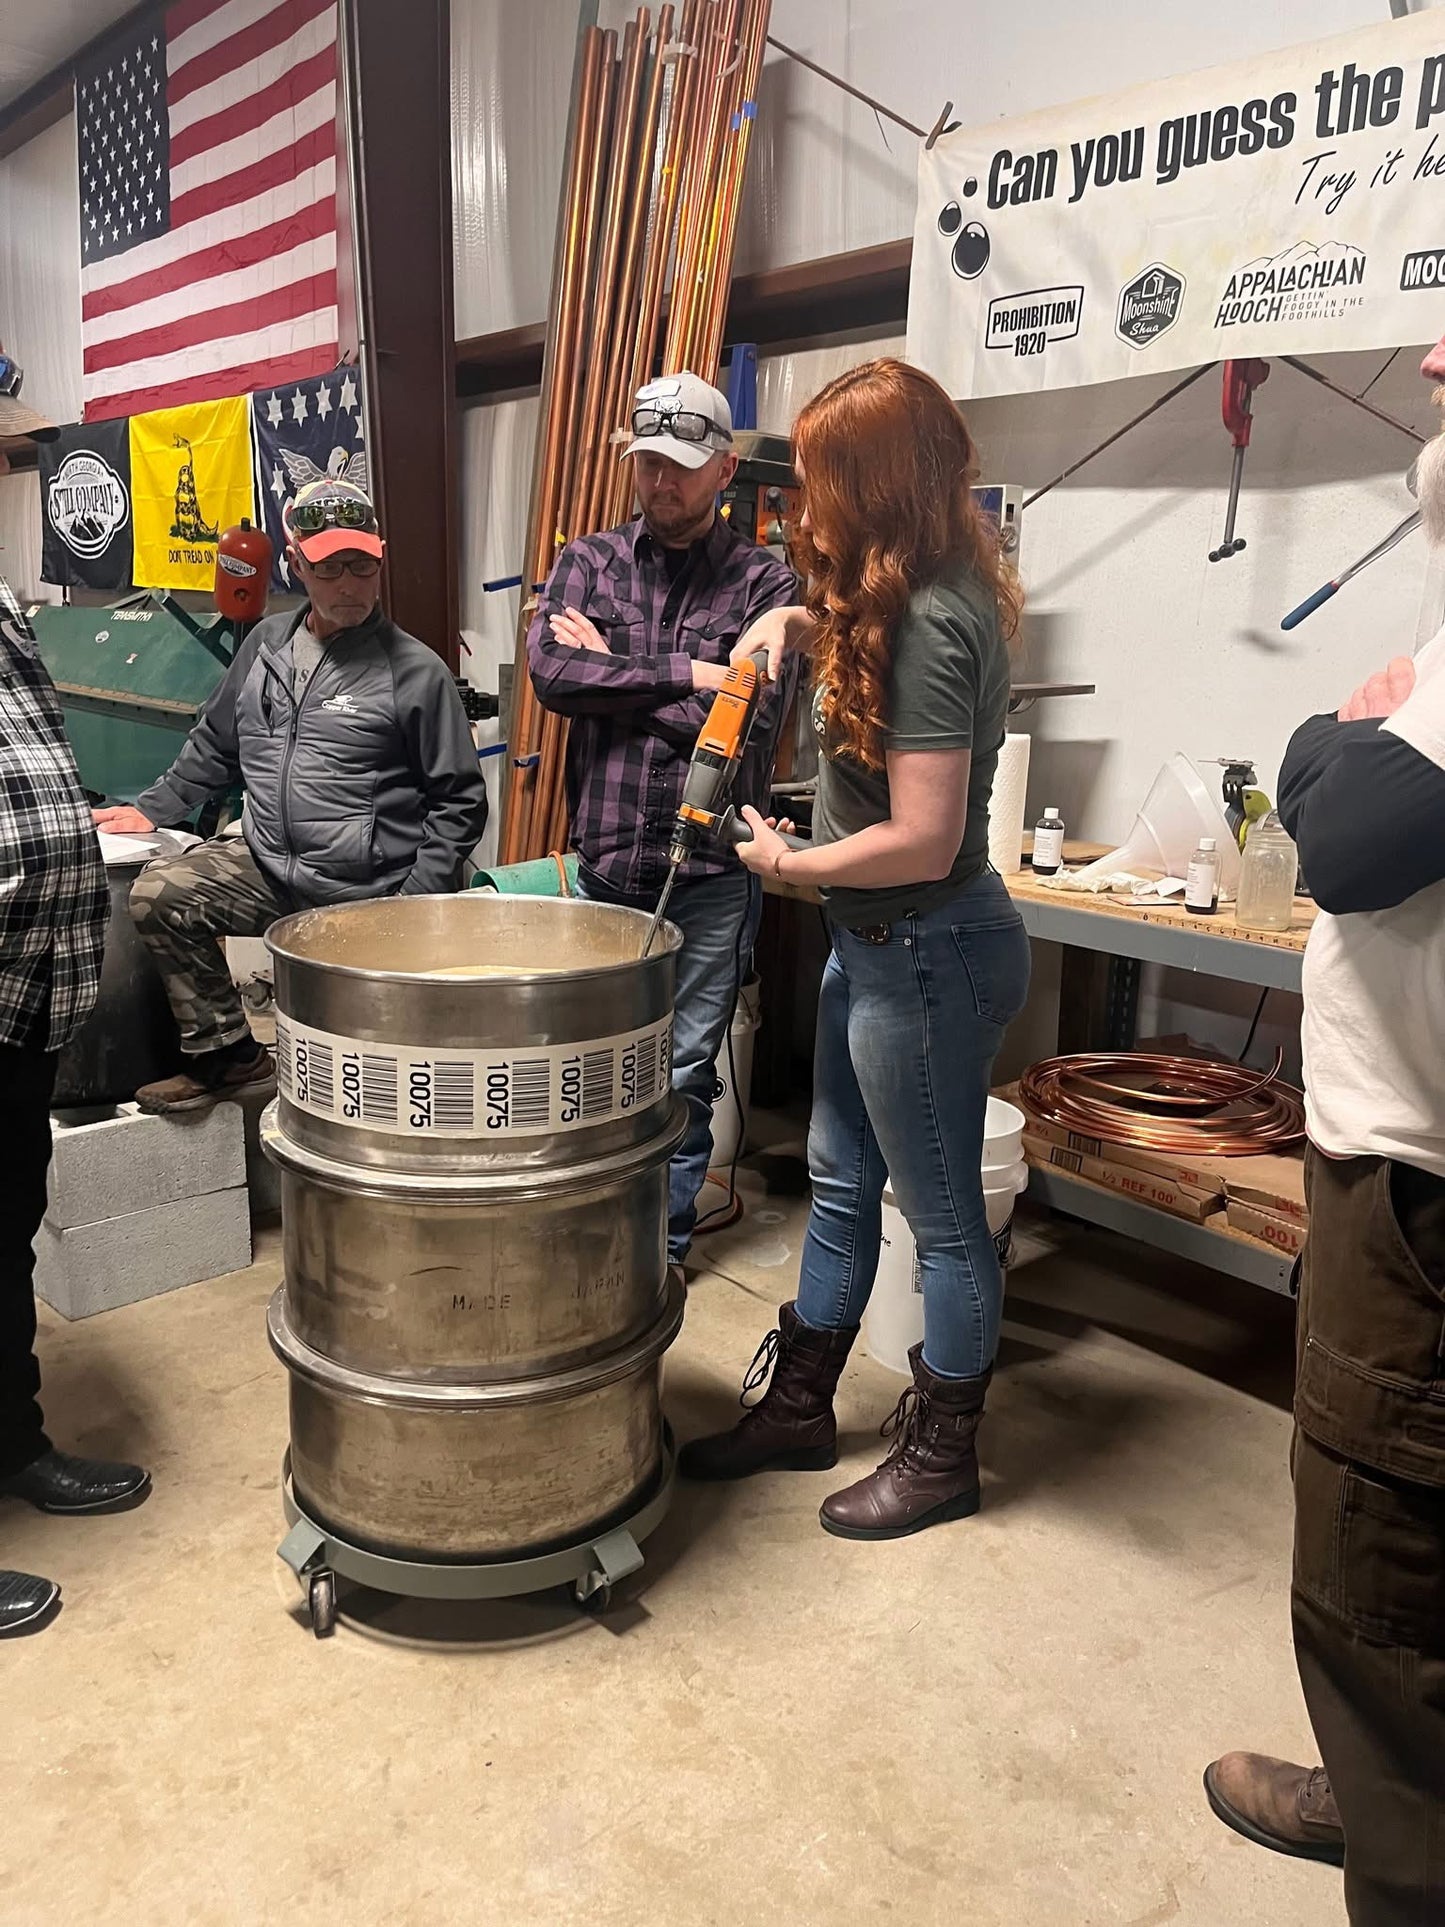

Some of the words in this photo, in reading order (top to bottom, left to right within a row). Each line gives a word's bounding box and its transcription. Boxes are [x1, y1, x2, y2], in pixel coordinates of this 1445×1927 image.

[987, 149, 1058, 210] Can
[1068, 126, 1145, 203] you
[1156, 92, 1297, 185] guess
[1314, 63, 1404, 138] the
[1295, 151, 1357, 215] Try
[1370, 148, 1405, 188] it
[1222, 256, 1366, 301] APPALACHIAN
[992, 299, 1077, 334] PROHIBITION
[1214, 295, 1284, 328] HOOCH
[1281, 308, 1345, 320] FOOTHILLS
[1284, 301, 1319, 311] FOGGY
[1325, 299, 1337, 308] IN
[1343, 296, 1364, 307] THE
[1014, 331, 1046, 356] 1920
[1130, 322, 1159, 335] Shua
[183, 549, 203, 563] TREAD
[204, 549, 215, 563] ON
[296, 1038, 309, 1103] 10075
[342, 1052, 361, 1119] 10075
[560, 1055, 581, 1122] 10075
[621, 1042, 636, 1109] 10075
[409, 1061, 431, 1128] 10075
[486, 1062, 509, 1129] 10075
[1121, 1177, 1147, 1193] REF
